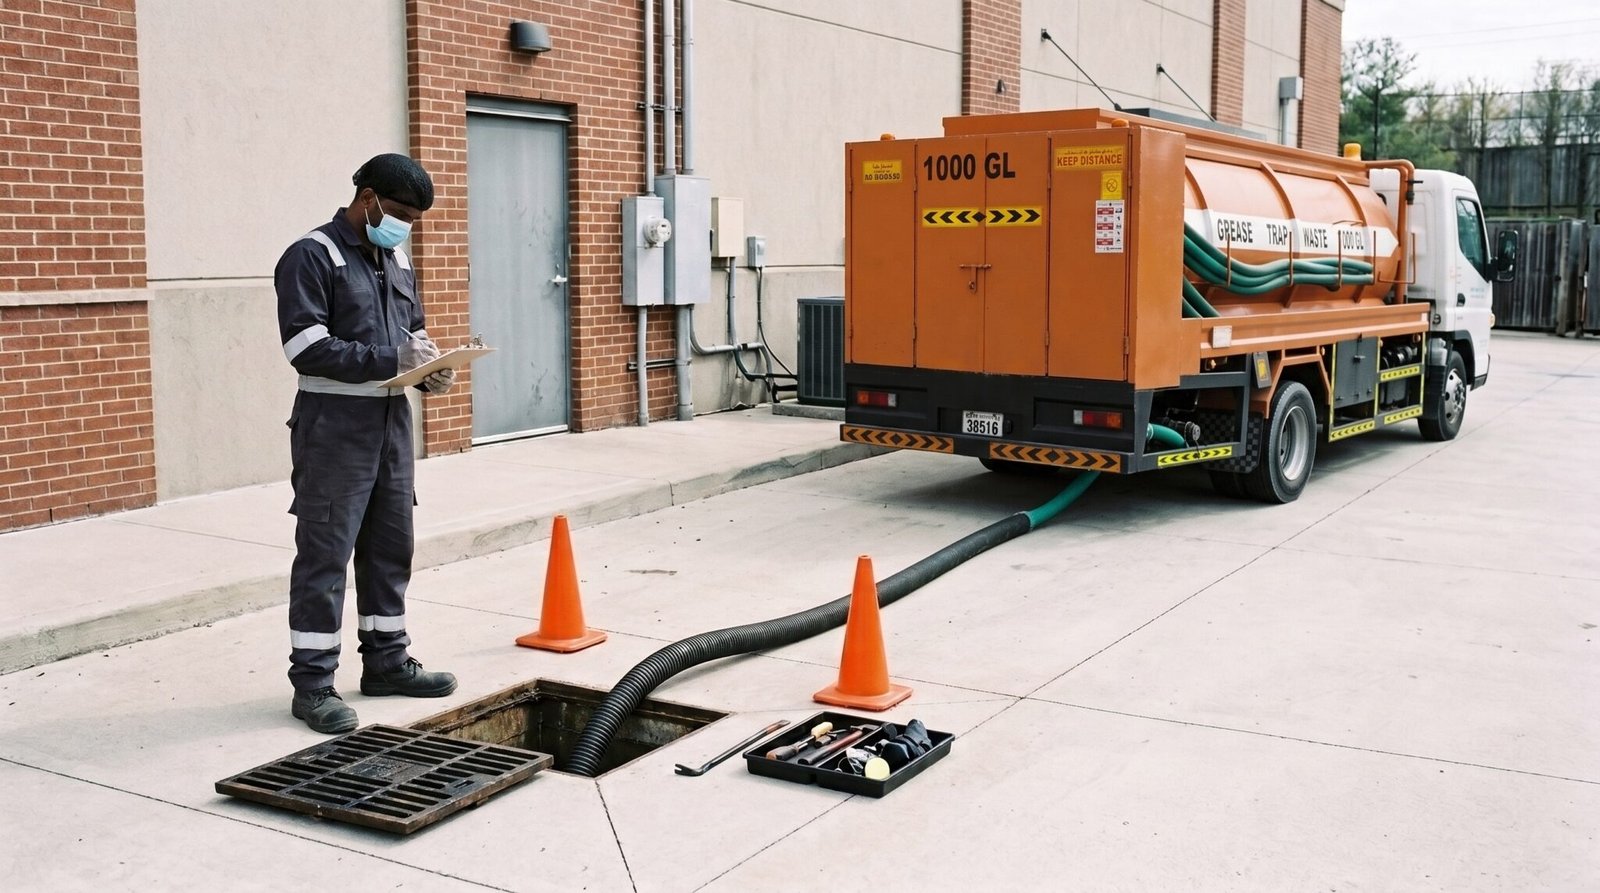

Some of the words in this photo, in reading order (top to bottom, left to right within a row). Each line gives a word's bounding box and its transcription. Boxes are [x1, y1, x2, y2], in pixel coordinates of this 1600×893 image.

[923, 153, 976, 181] 1000
[984, 152, 1016, 179] GL
[1057, 156, 1079, 167] KEEP
[1080, 154, 1122, 166] DISTANCE
[1217, 218, 1253, 243] GREASE
[1266, 223, 1288, 246] TRAP
[1302, 227, 1328, 249] WASTE
[1338, 230, 1354, 250] 000
[967, 419, 999, 435] 38516
